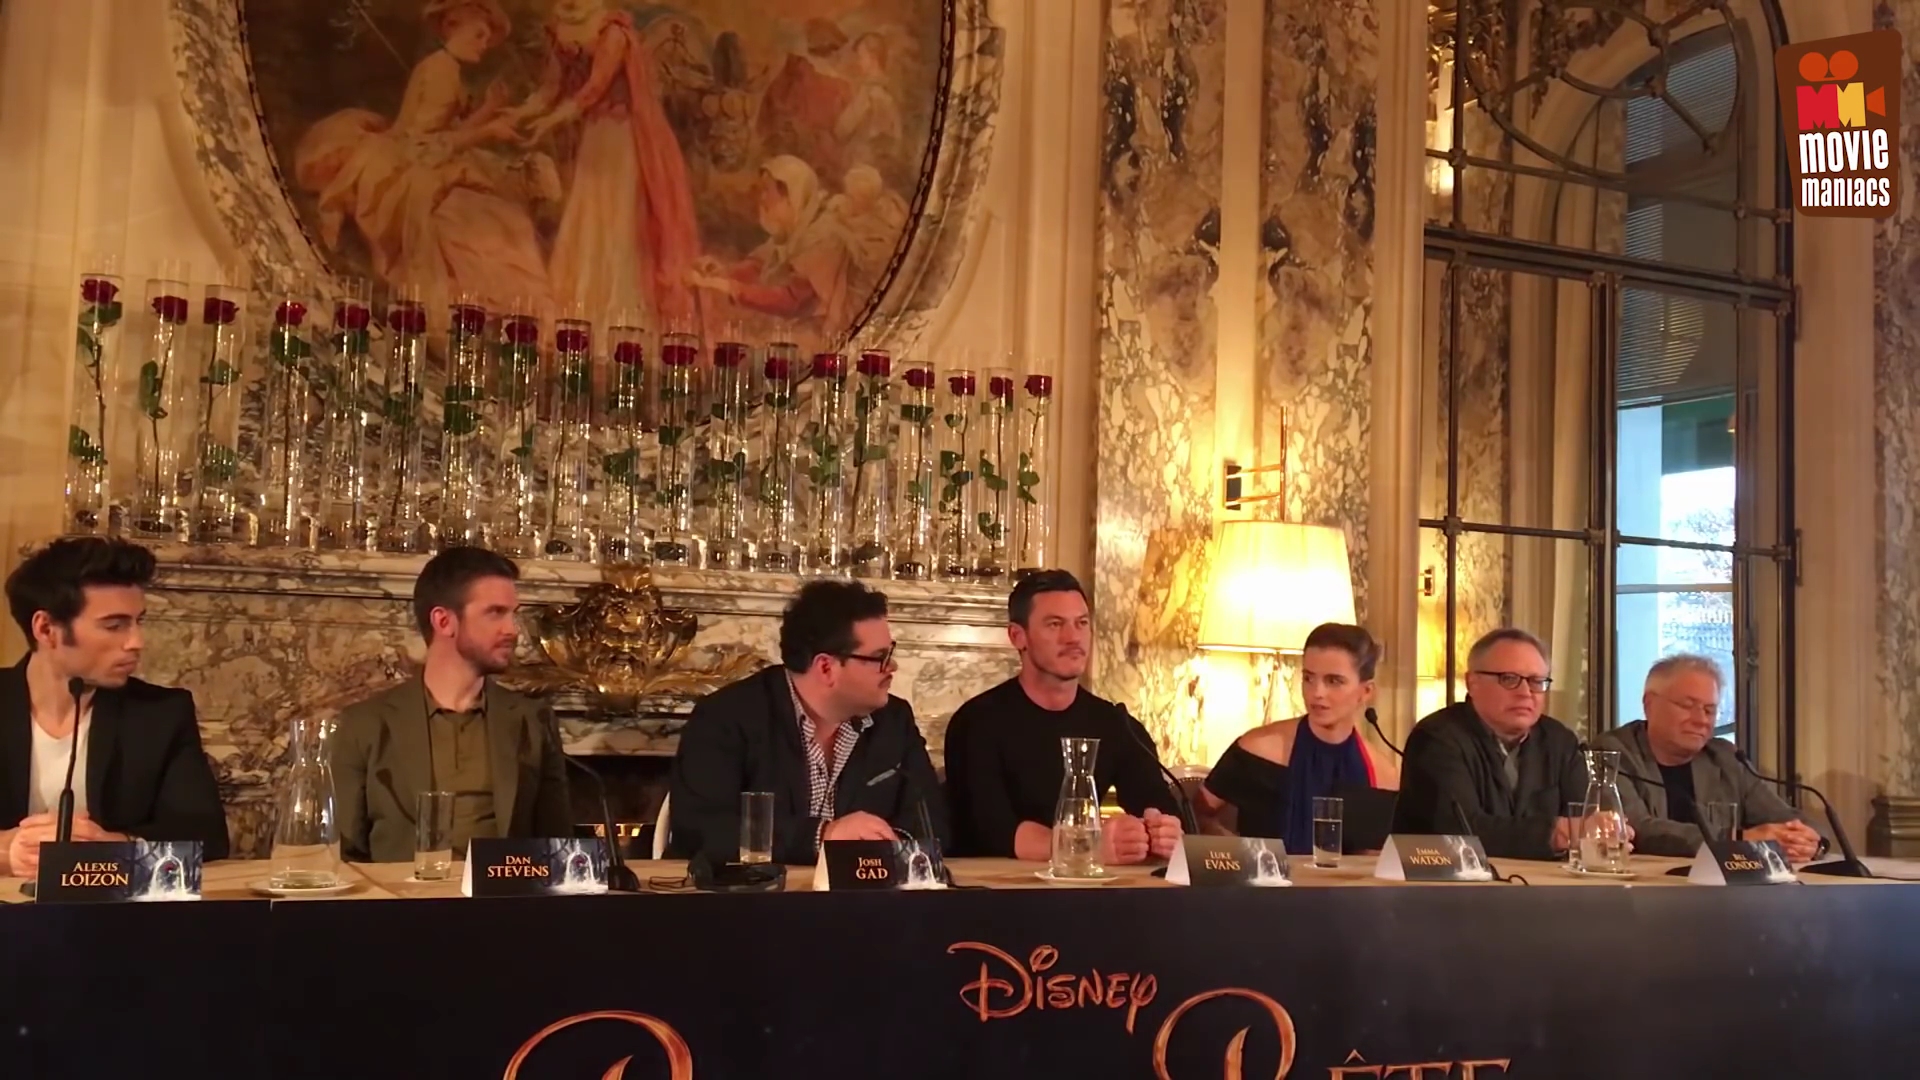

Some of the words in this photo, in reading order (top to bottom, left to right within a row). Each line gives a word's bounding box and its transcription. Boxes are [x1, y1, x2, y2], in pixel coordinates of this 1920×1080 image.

[505, 855, 531, 865] DAN
[1209, 850, 1232, 860] LUKE
[1409, 855, 1452, 865] WATSON
[73, 862, 119, 872] ALEXIS
[858, 857, 882, 867] JOSH
[1204, 859, 1241, 871] EVANS
[1724, 861, 1764, 871] CONDON
[487, 865, 549, 878] STEVENS
[856, 868, 888, 880] GAD
[61, 873, 129, 887] LOIZON
